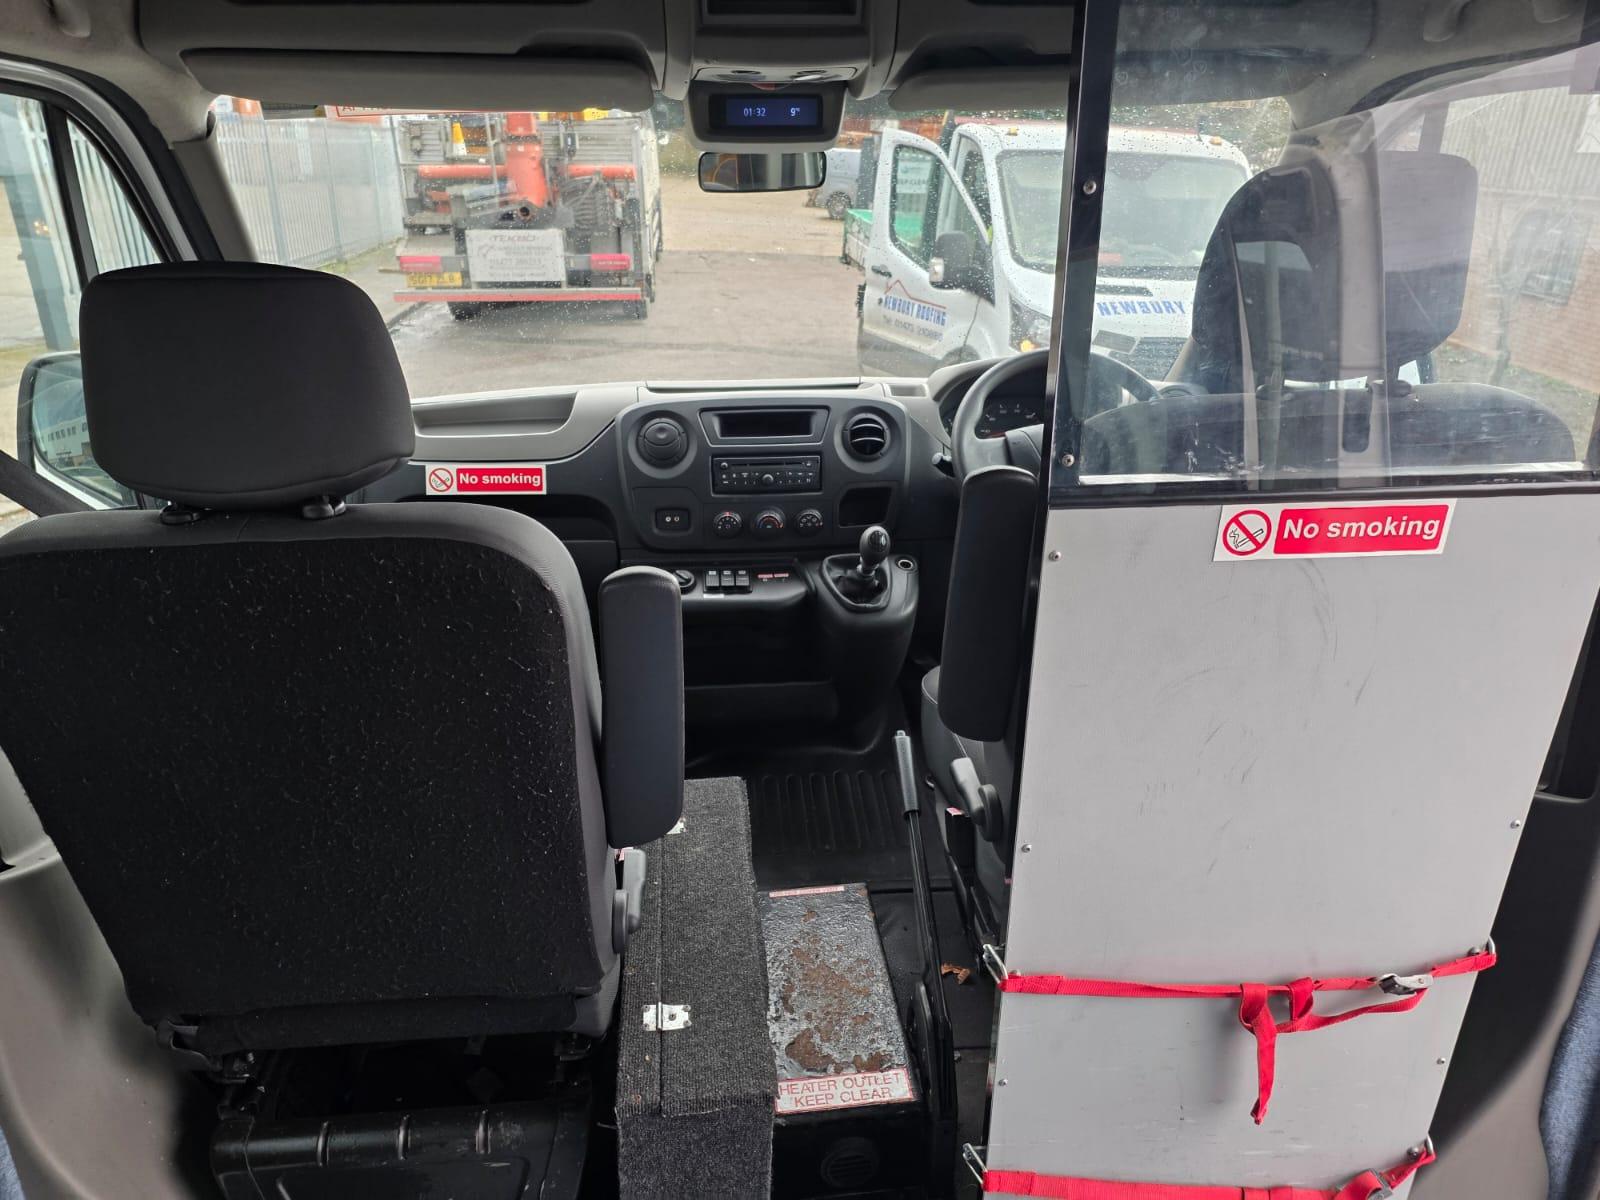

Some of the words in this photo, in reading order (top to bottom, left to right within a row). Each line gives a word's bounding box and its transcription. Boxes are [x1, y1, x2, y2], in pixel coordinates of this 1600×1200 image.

[743, 107, 767, 117] 01:32
[884, 295, 914, 317] NEWBURY
[916, 303, 947, 326] ROOFING
[1096, 300, 1186, 316] NEWBURY
[459, 473, 478, 485] No
[482, 472, 541, 487] smoking
[1283, 518, 1320, 539] No
[1326, 516, 1441, 541] smoking
[779, 1079, 838, 1096] HEATER
[842, 1072, 901, 1090] OUTLET
[795, 1092, 835, 1108] KEEP
[839, 1086, 893, 1103] CLEAR
